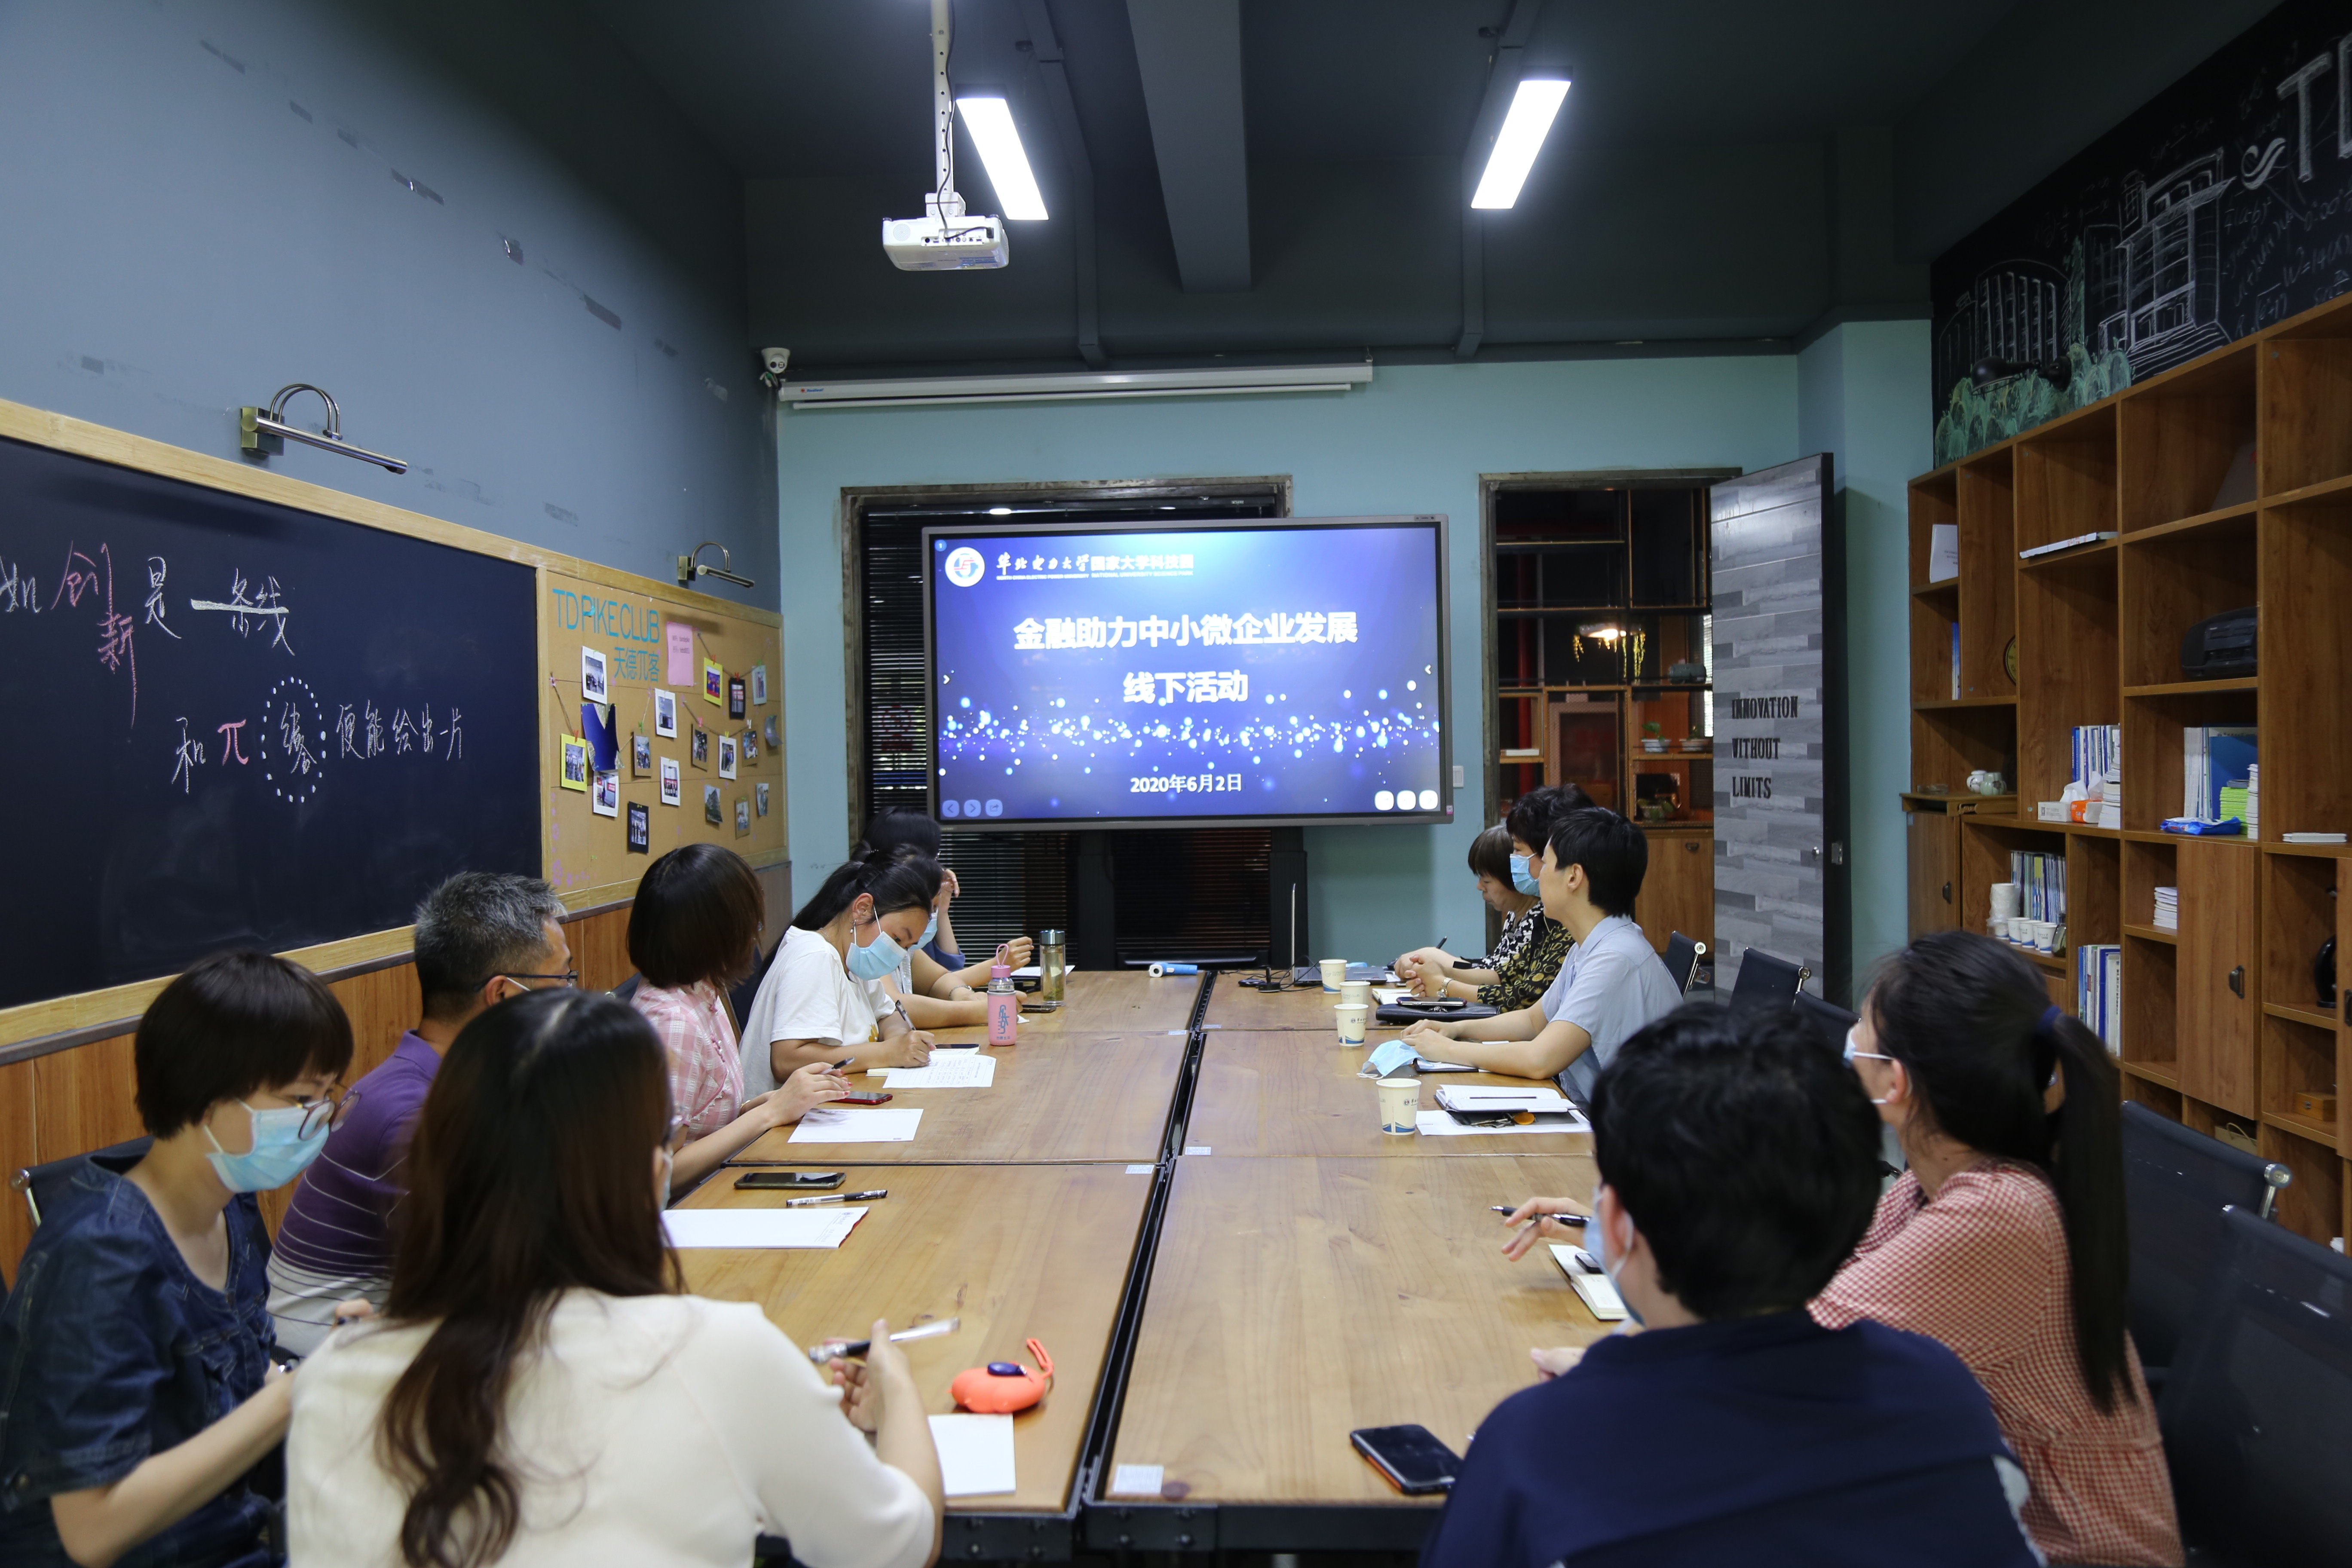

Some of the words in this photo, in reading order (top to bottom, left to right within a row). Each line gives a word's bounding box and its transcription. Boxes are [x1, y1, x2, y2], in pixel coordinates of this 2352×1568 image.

[1013, 612, 1359, 649] 金融助力中小微企业发展
[1123, 670, 1248, 704] 线下活动
[1732, 696, 1798, 719] INNOVATION
[1732, 738, 1780, 760] WITHOUT
[1130, 773, 1242, 793] 2020年6月2日
[1732, 776, 1771, 799] LIMITS
